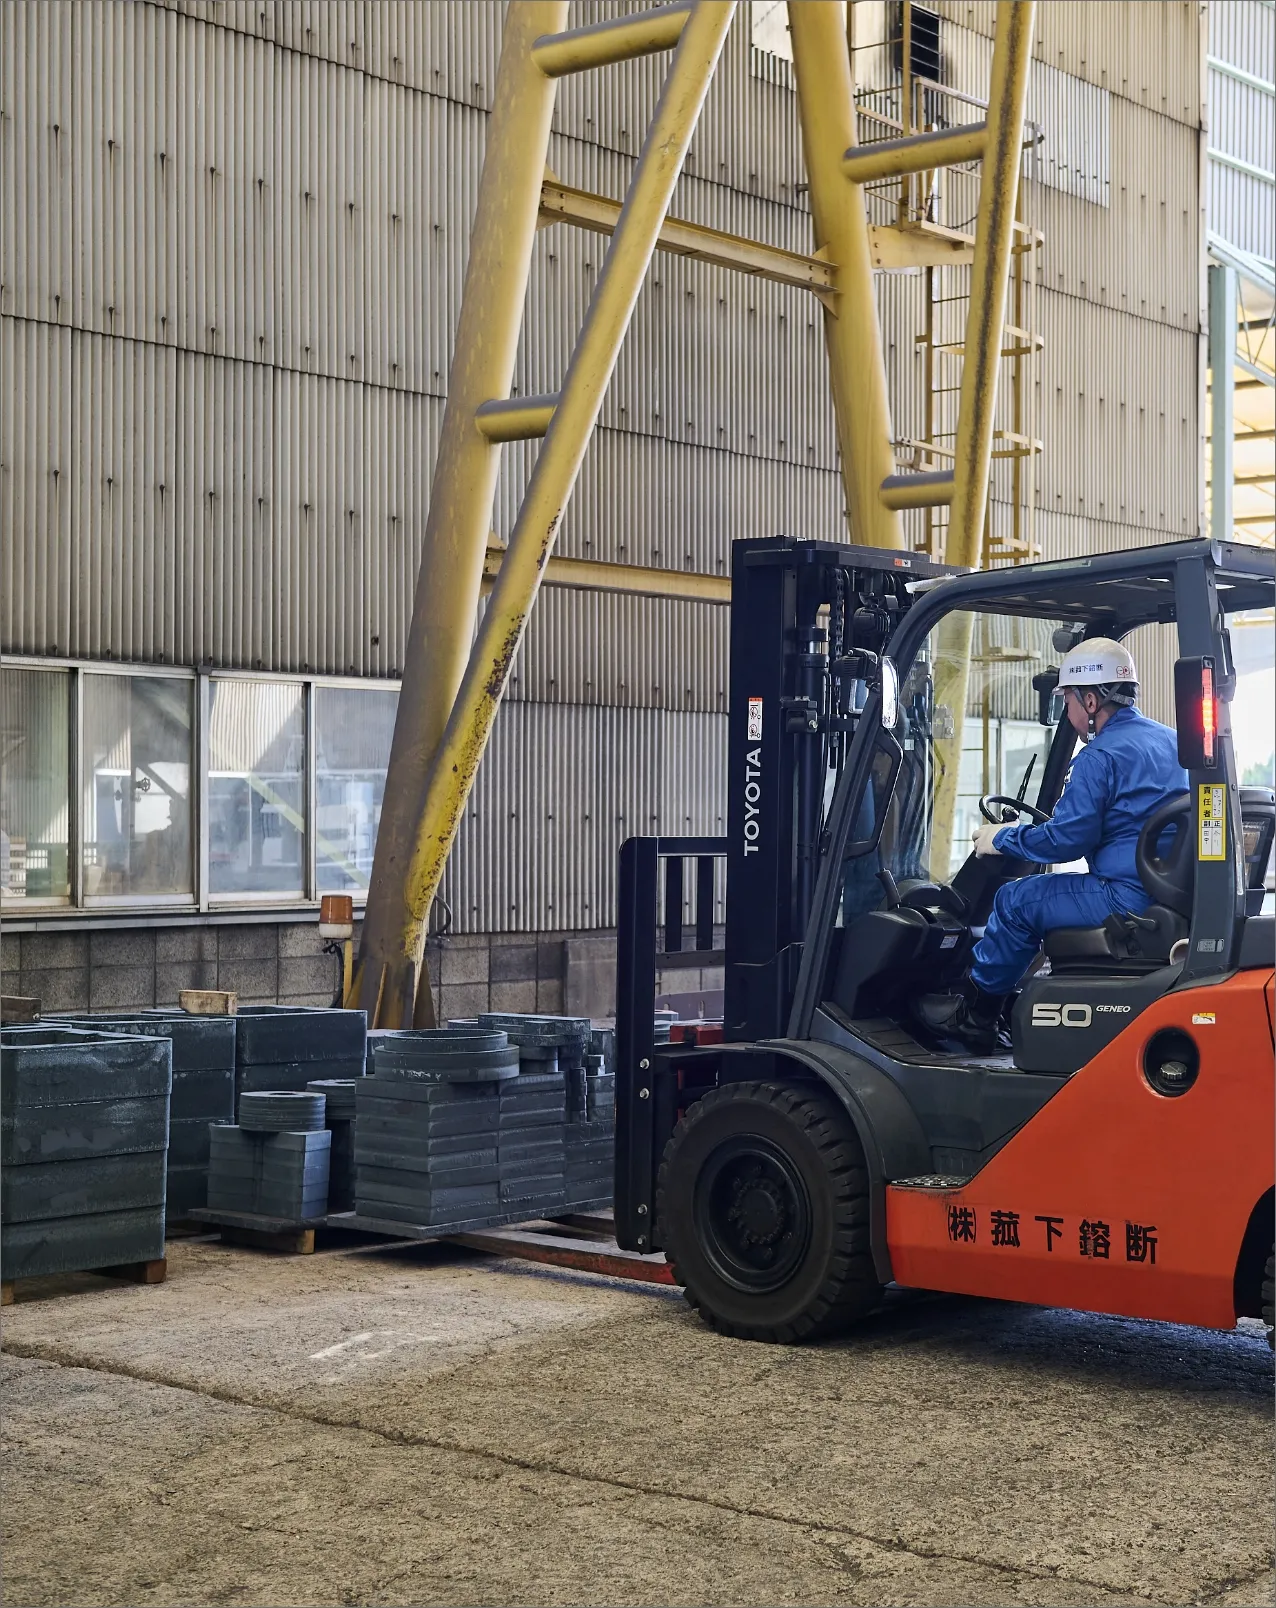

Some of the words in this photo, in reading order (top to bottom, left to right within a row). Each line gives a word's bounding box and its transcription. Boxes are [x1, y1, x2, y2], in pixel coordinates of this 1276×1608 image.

[744, 747, 762, 857] TOYOTA
[1203, 786, 1211, 818] 責任者
[1031, 1003, 1093, 1028] 50
[1096, 1004, 1131, 1014] GENEO
